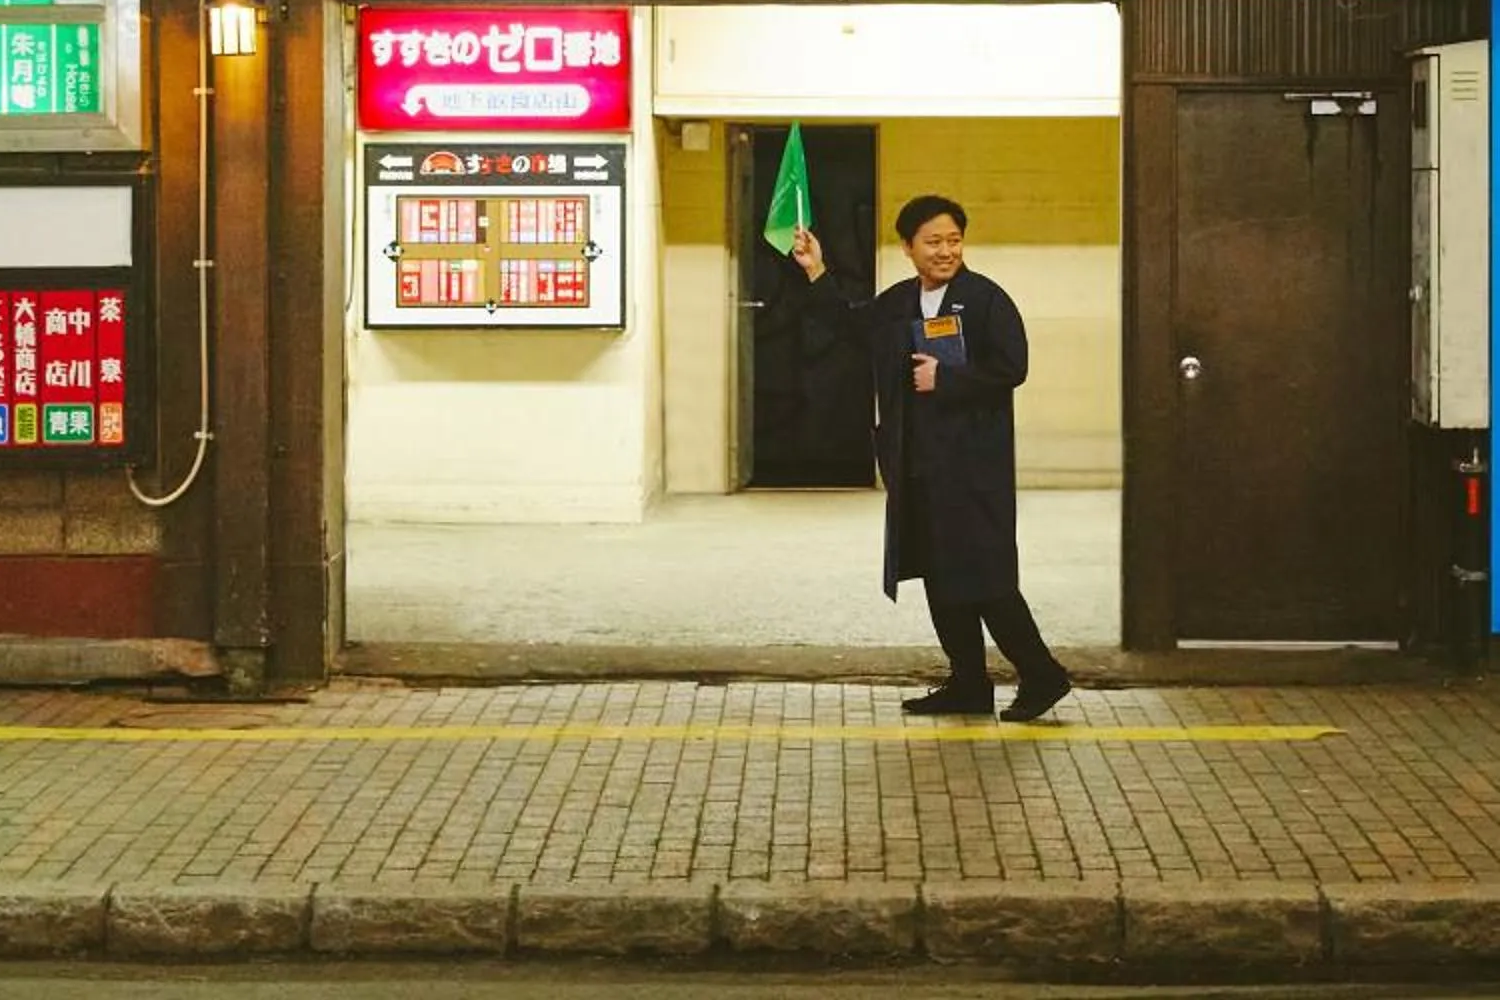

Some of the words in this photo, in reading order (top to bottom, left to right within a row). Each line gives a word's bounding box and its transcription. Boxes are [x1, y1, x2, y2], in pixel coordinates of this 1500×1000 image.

[369, 24, 621, 73] すすきのゼロ番地
[14, 297, 37, 396] 大橋商店
[68, 307, 91, 388] 中川
[49, 411, 90, 435] 青果
